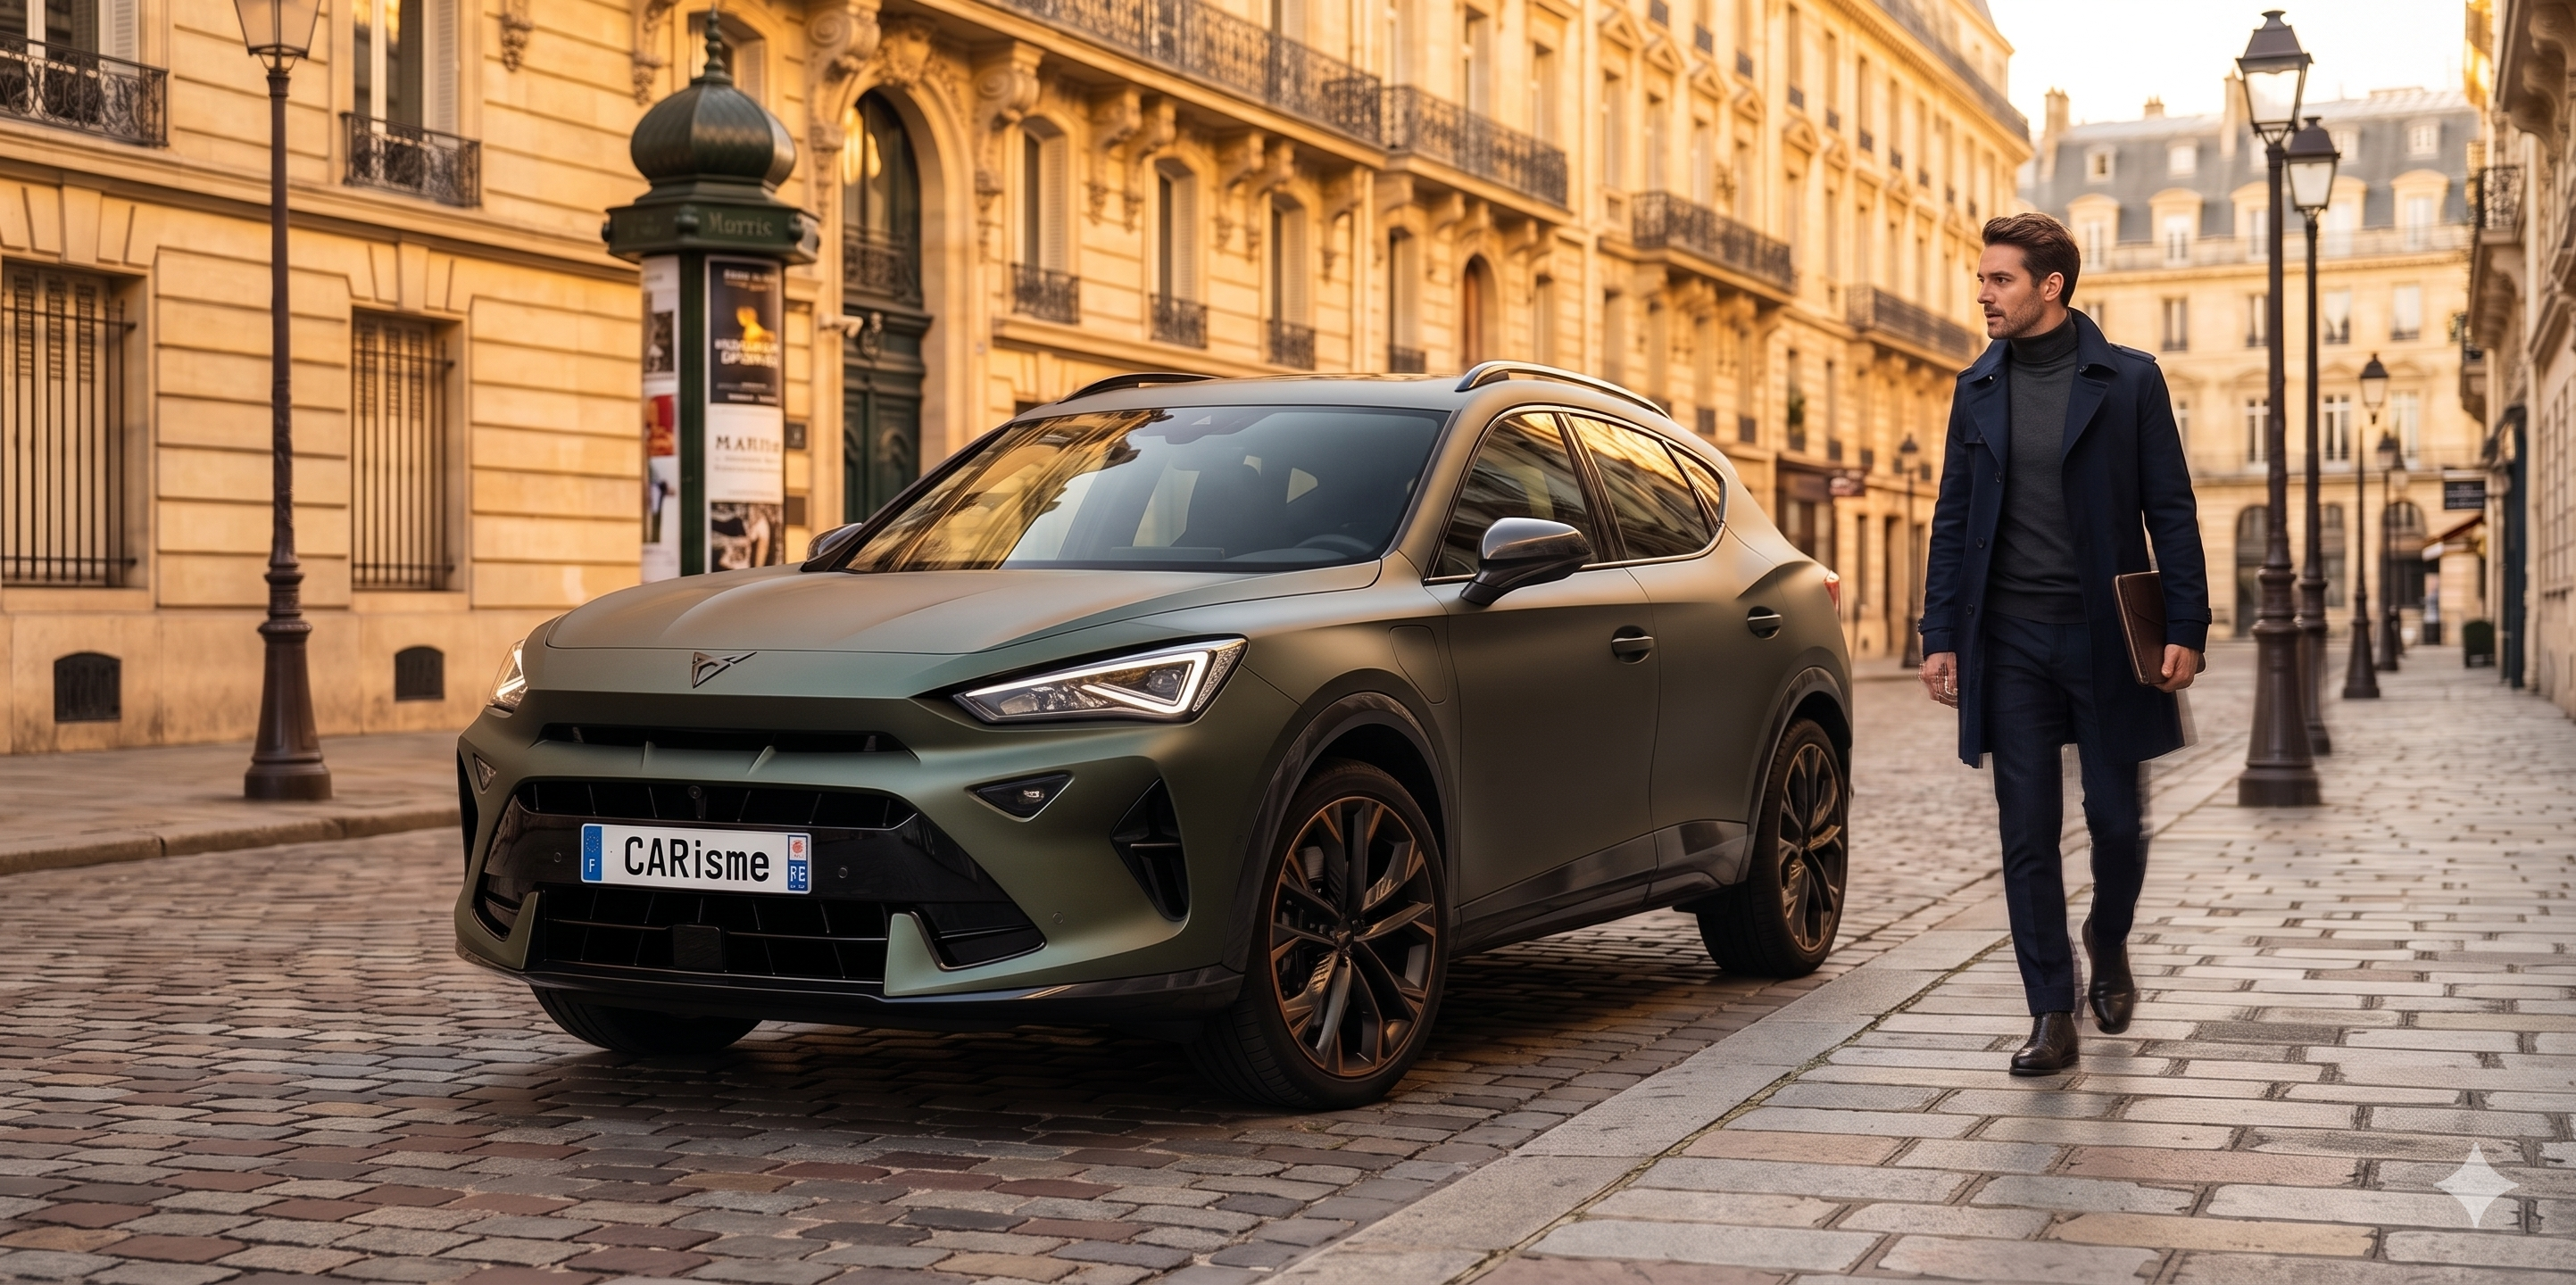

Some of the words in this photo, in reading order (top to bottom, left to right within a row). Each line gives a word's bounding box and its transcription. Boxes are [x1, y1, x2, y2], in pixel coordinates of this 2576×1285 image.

[589, 858, 595, 873] F
[625, 836, 769, 882] CARisme
[790, 866, 806, 882] RE
